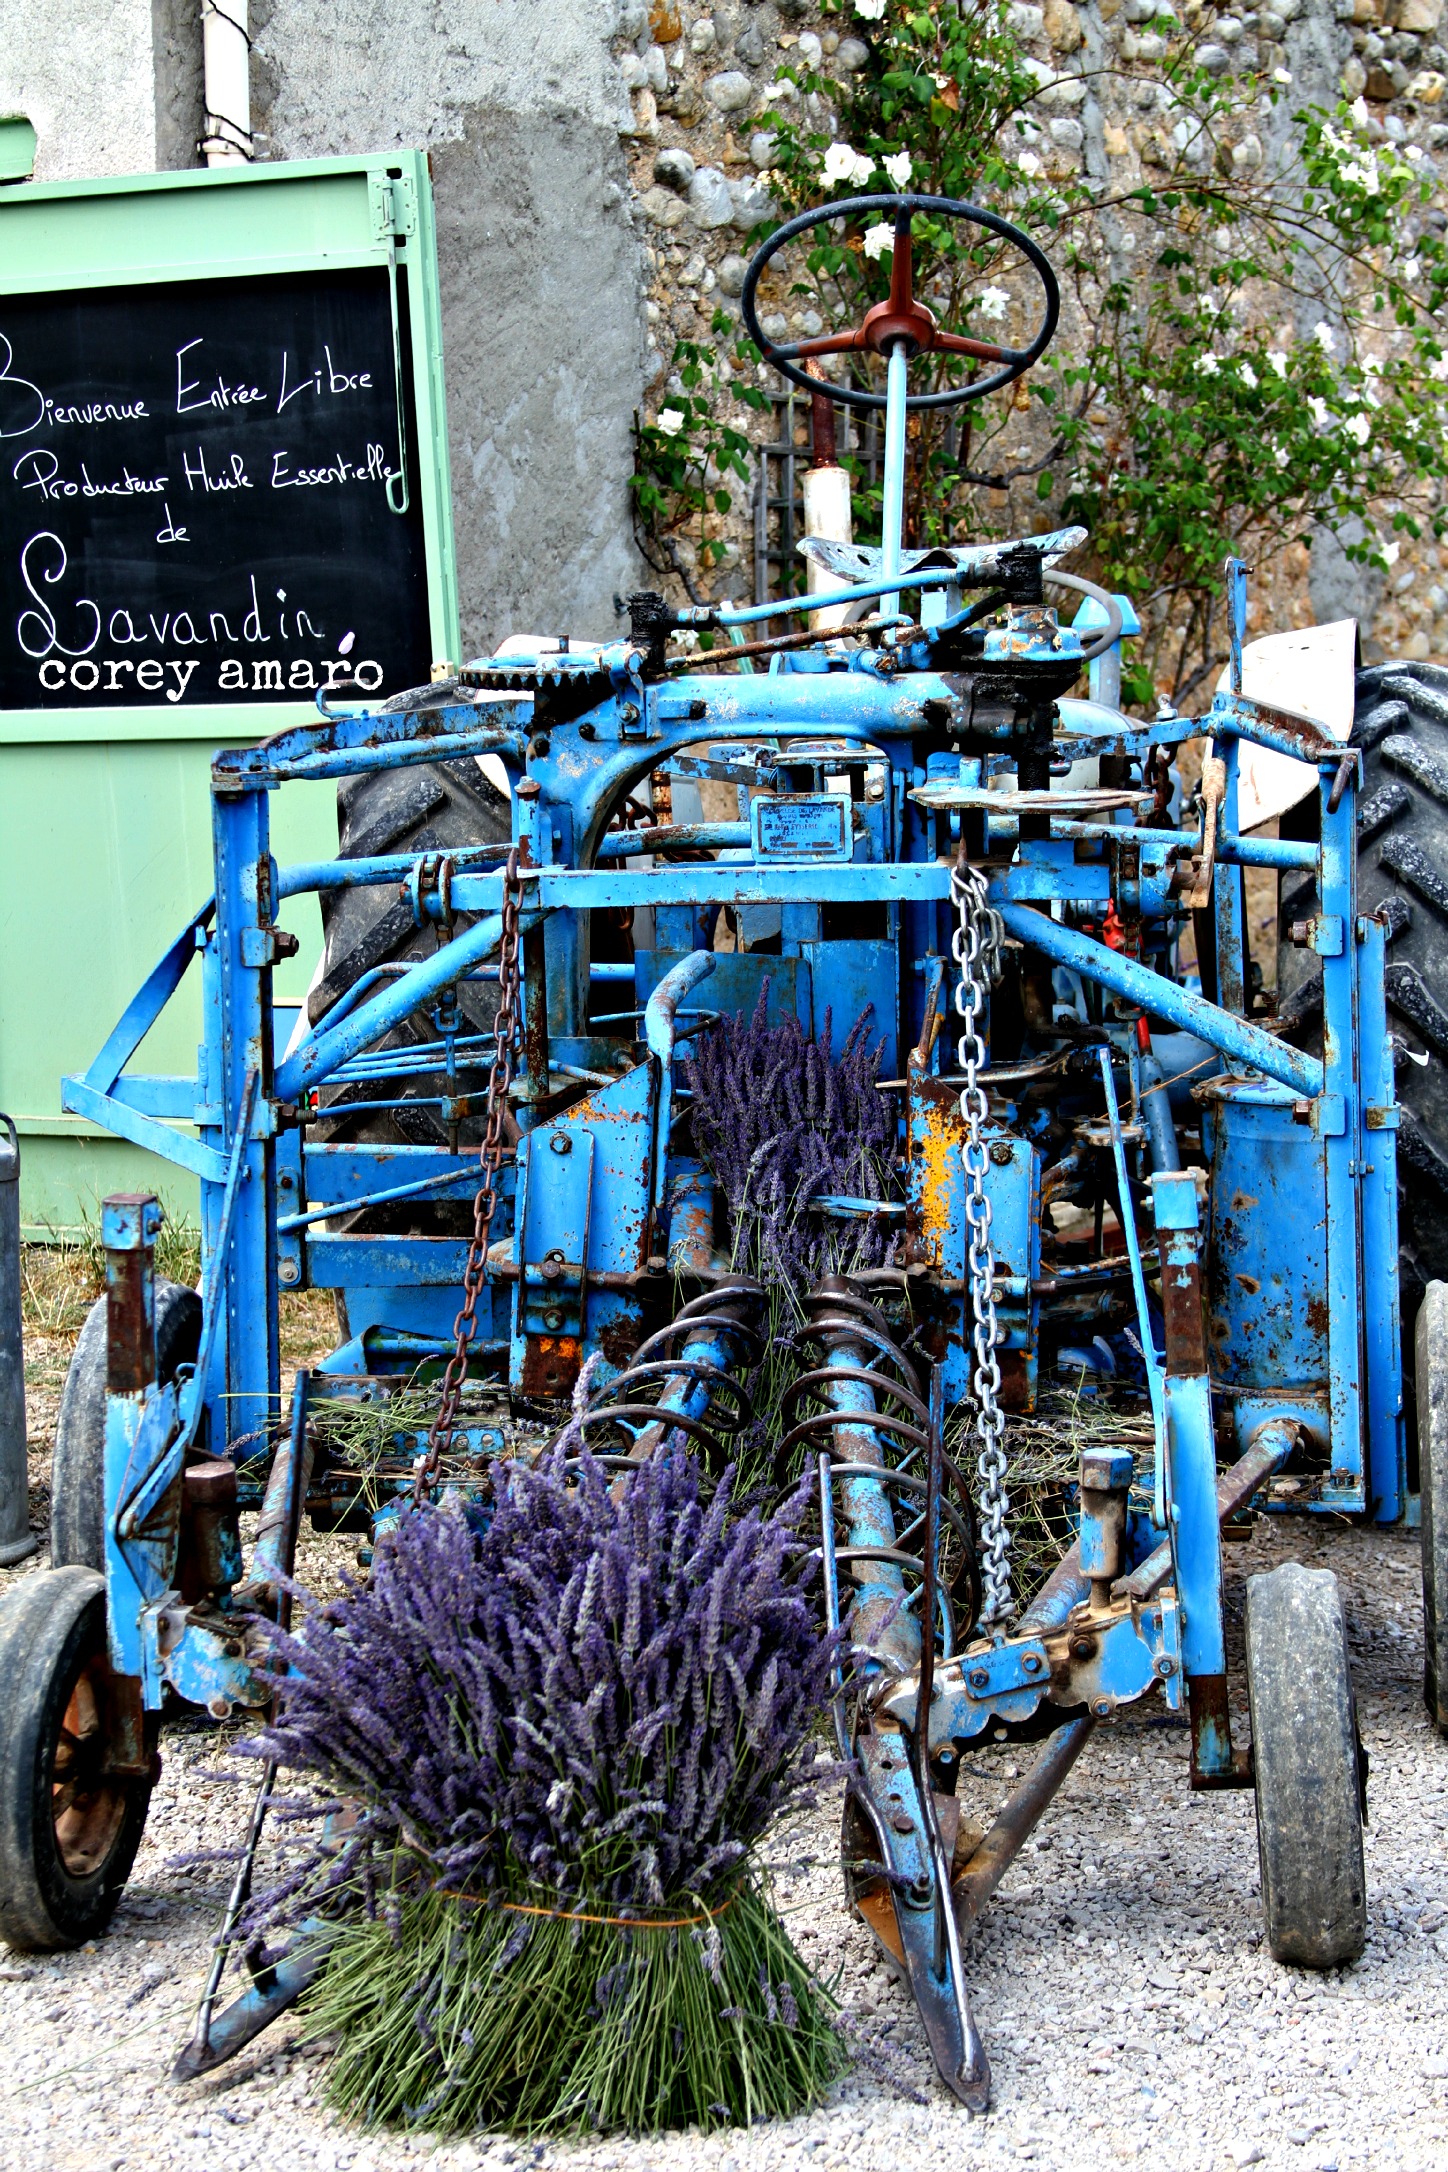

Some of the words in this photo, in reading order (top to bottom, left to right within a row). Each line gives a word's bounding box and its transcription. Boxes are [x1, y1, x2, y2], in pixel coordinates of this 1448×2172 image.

[0, 332, 150, 437] Bienvenue
[176, 338, 267, 413] Entrée
[277, 345, 373, 413] Libre
[13, 449, 169, 499] Producteur
[183, 446, 254, 492] Huile
[156, 503, 191, 543] de
[17, 531, 326, 658] Lavandin
